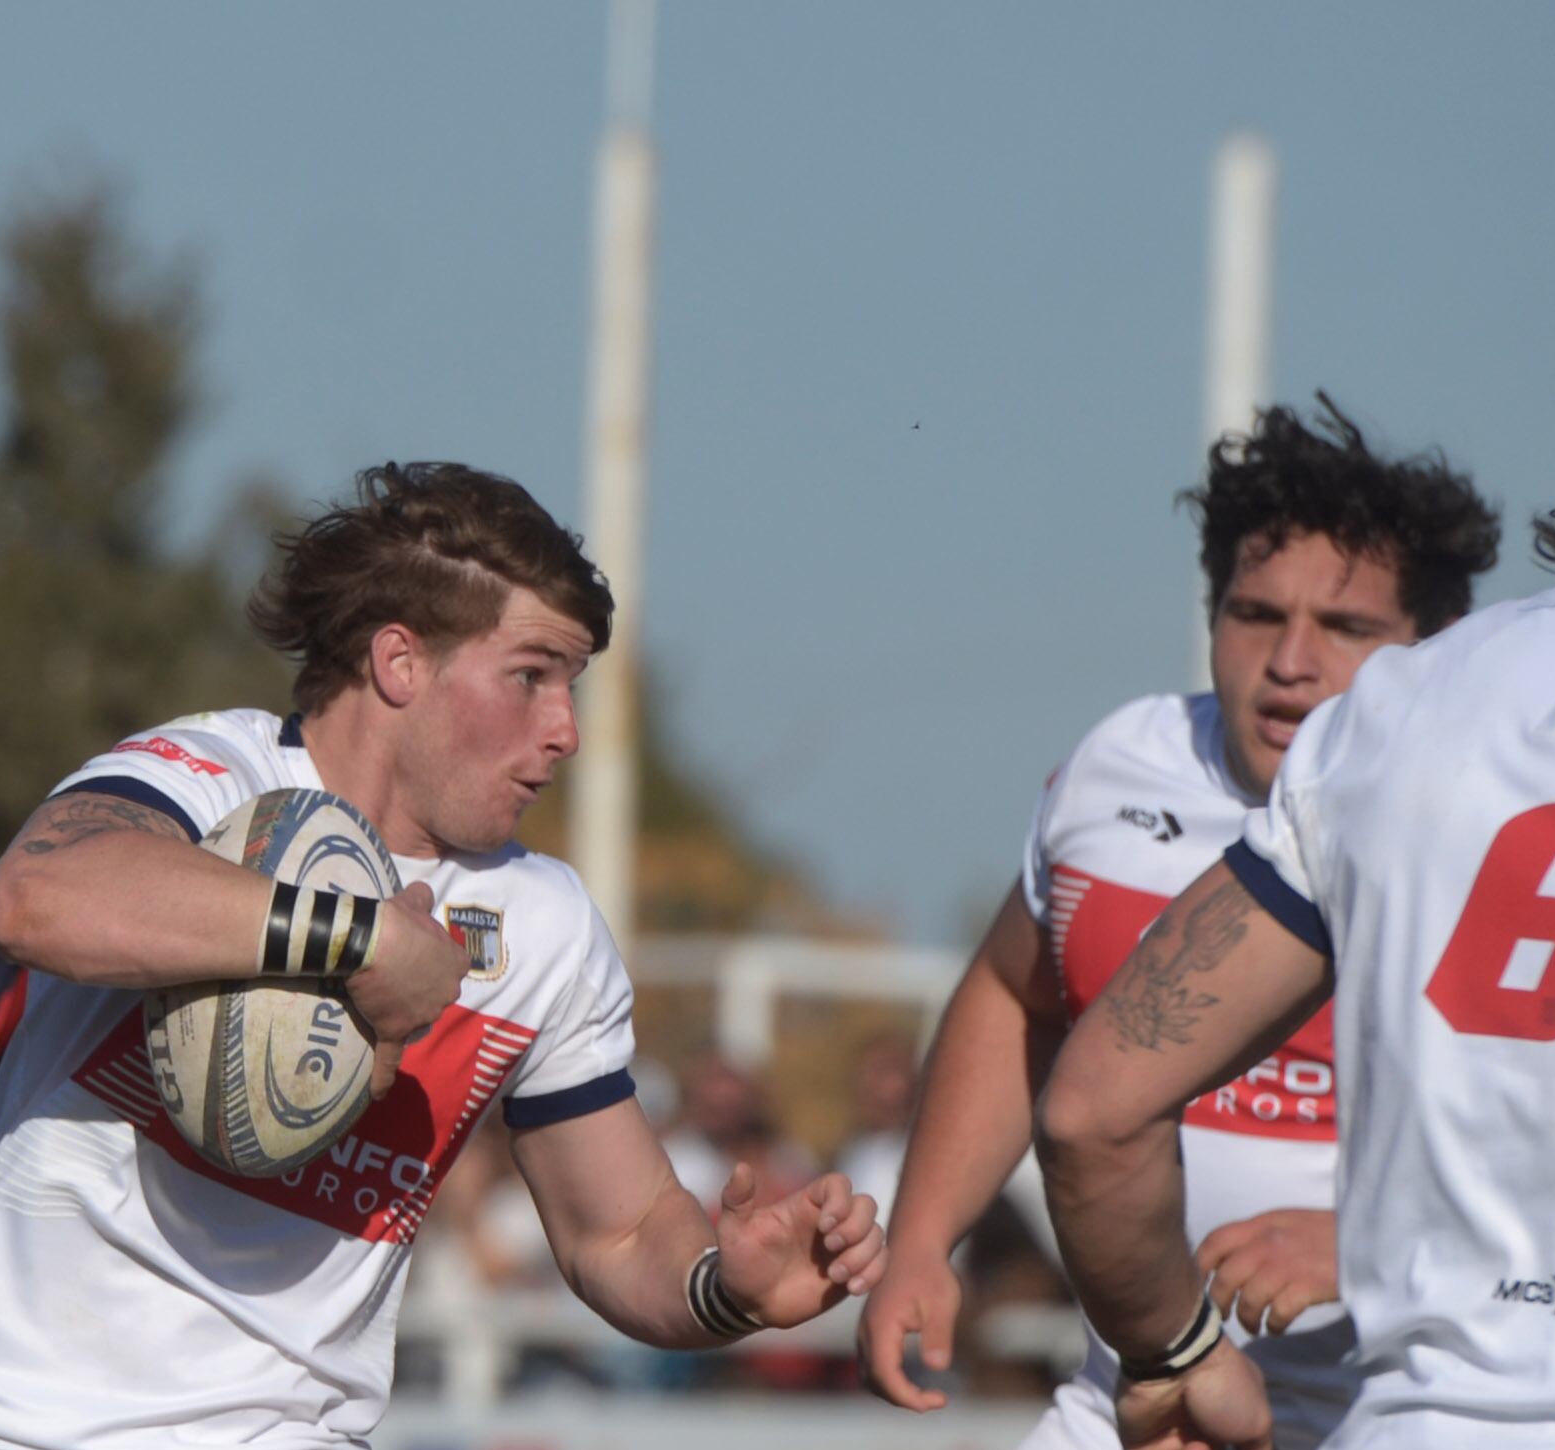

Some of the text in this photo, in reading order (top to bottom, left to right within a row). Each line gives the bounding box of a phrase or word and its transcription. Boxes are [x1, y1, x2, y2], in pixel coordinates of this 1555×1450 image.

[448, 908, 498, 928] MARISTA
[329, 1134, 431, 1194] NFO
[1493, 1277, 1553, 1306] MC3
